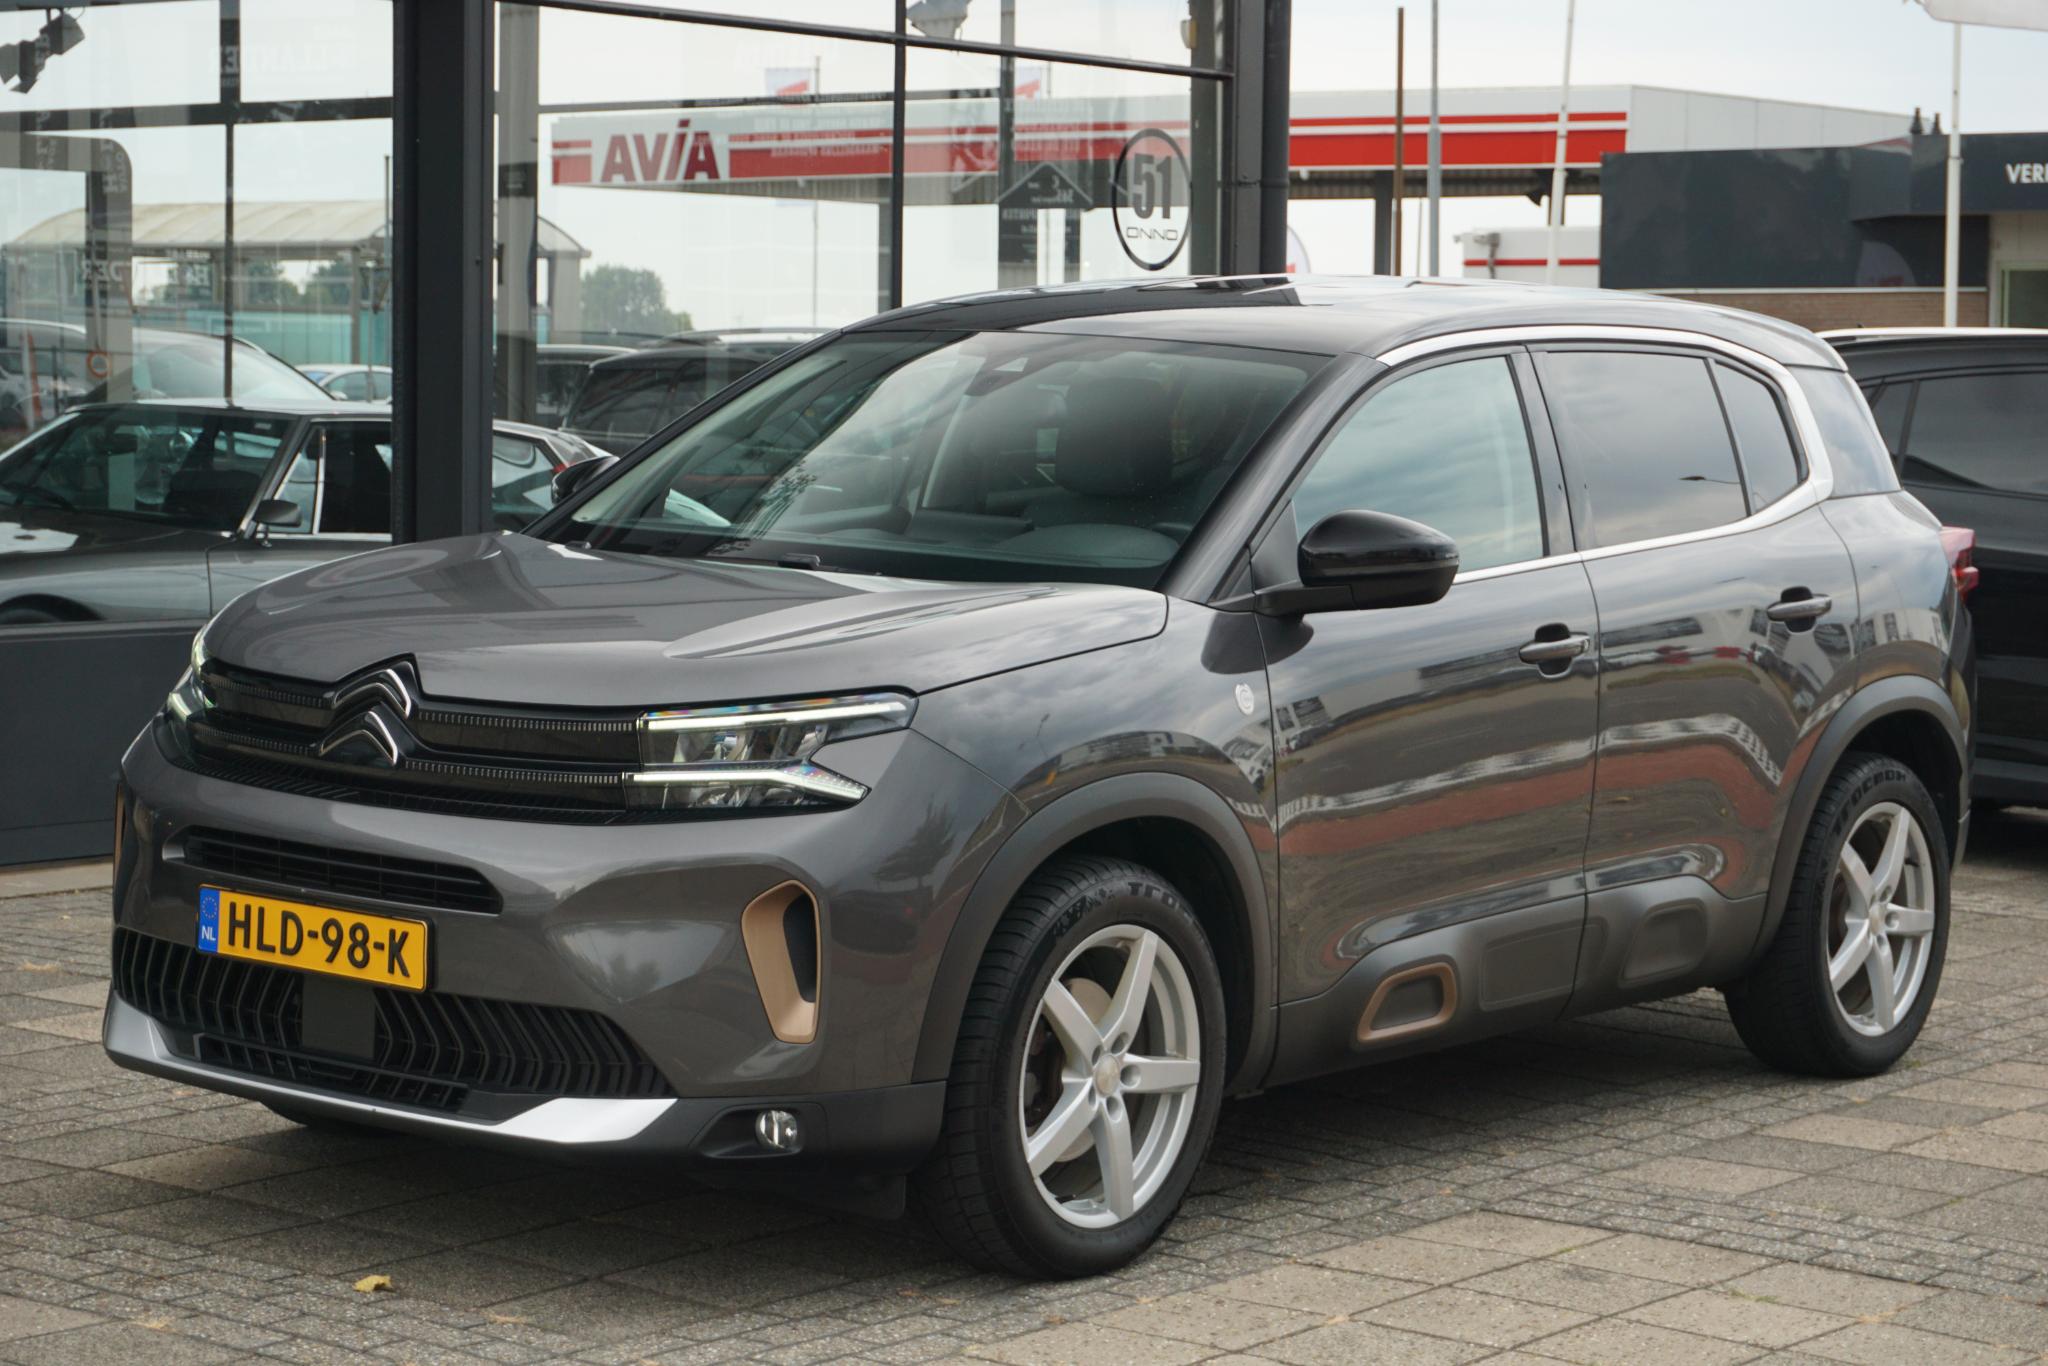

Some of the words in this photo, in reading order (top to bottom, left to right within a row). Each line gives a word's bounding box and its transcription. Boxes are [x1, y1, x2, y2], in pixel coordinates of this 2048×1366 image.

[1133, 152, 1172, 219] 51
[2004, 161, 2048, 185] VER
[201, 924, 216, 941] NL
[228, 901, 410, 978] HLD-98-K
